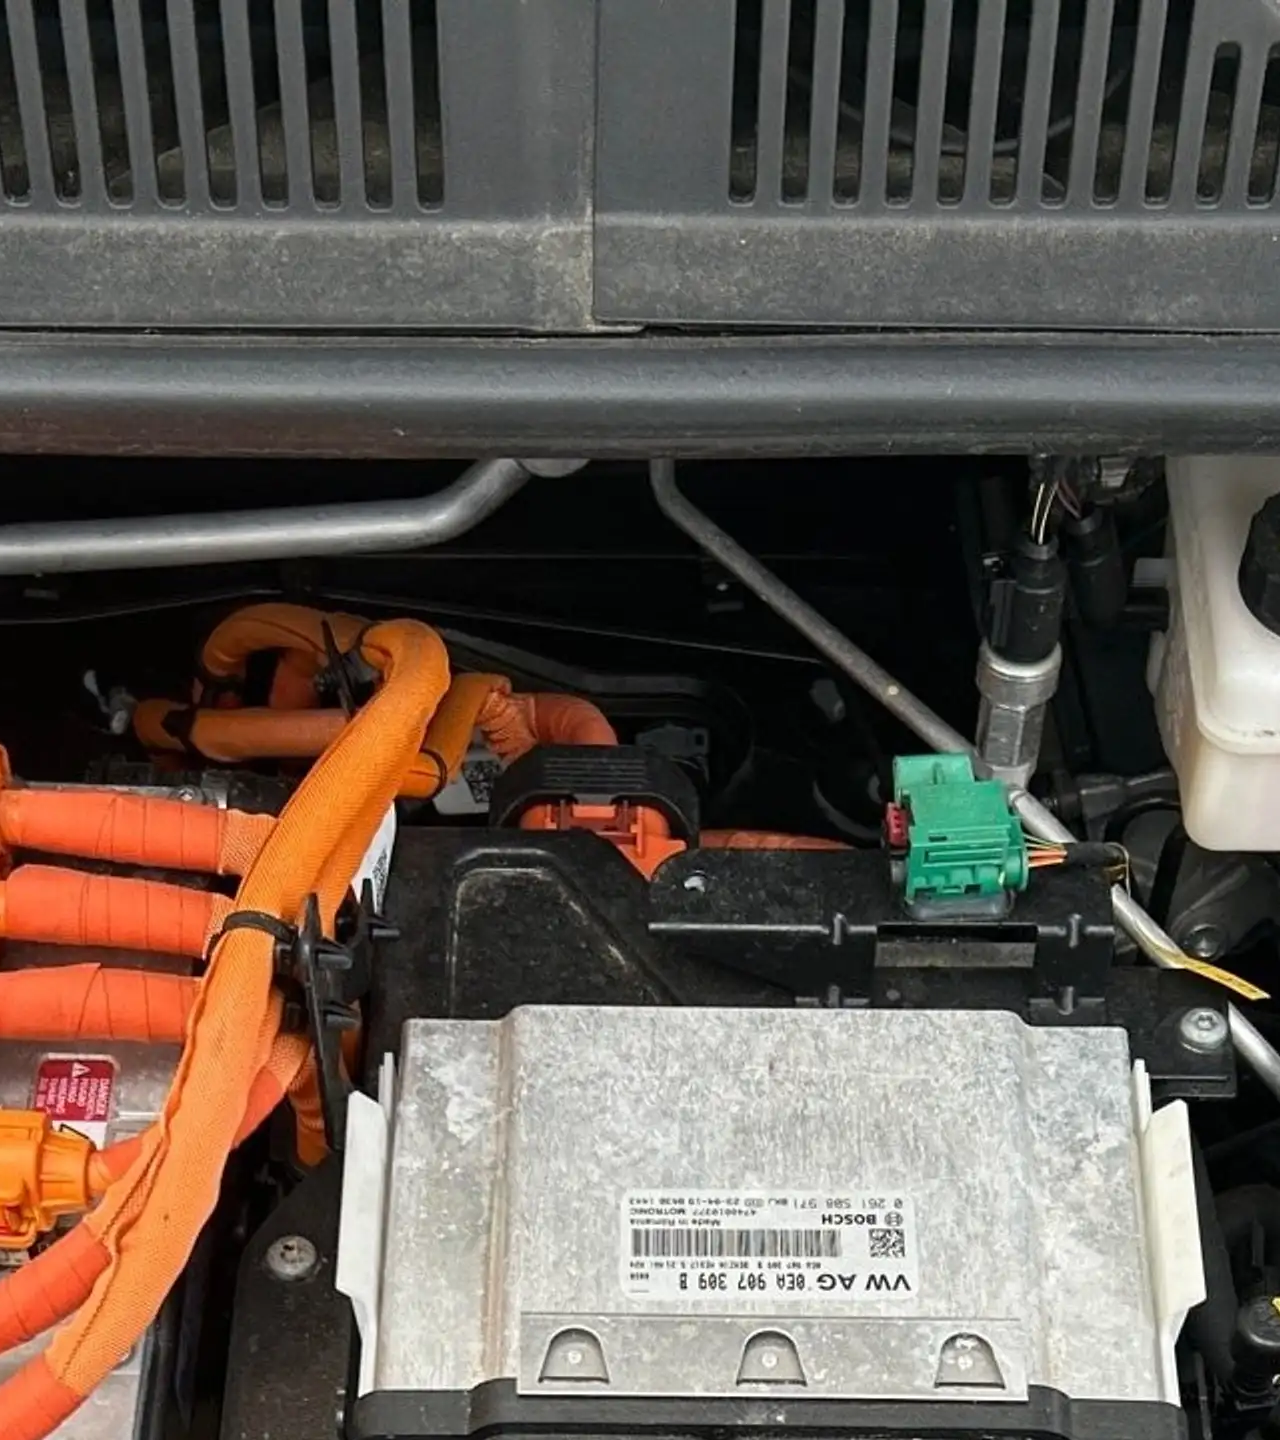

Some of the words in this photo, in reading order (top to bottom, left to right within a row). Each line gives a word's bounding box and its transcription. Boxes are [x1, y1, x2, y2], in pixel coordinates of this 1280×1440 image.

[629, 1208, 686, 1216] MOTRONIC
[821, 1213, 877, 1226] BOSCH
[629, 1217, 676, 1227] Romania
[677, 1217, 689, 1227] in
[691, 1217, 721, 1227] Made
[678, 1272, 688, 1291] B
[698, 1272, 728, 1291] 309
[737, 1272, 767, 1291] 907
[816, 1273, 858, 1292] AG
[864, 1273, 912, 1292] VW
